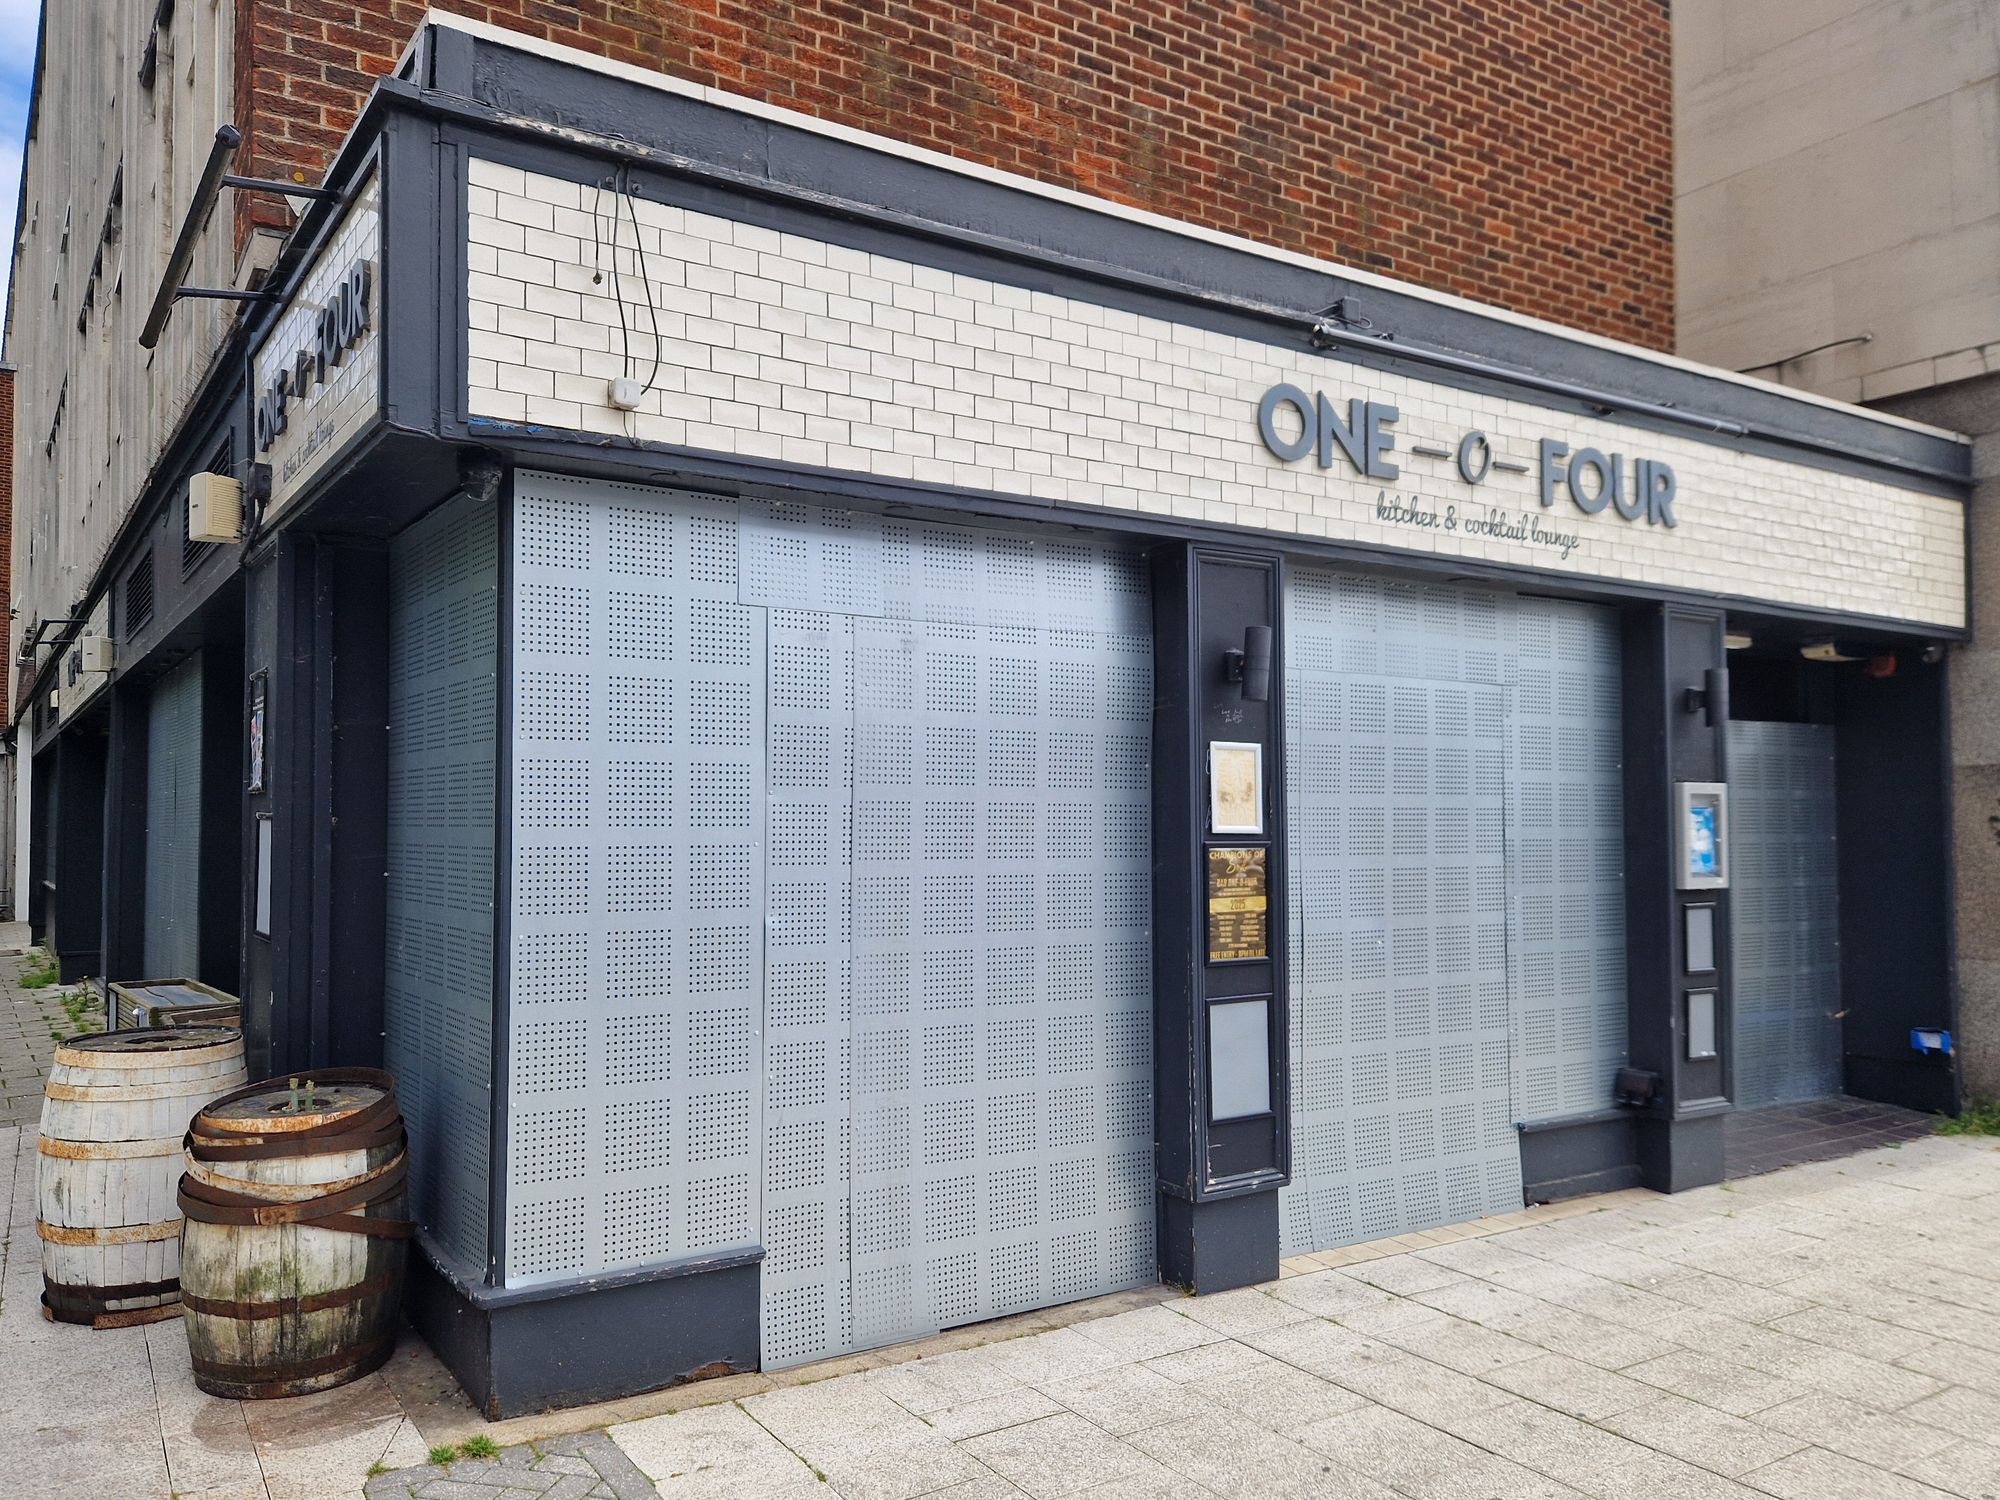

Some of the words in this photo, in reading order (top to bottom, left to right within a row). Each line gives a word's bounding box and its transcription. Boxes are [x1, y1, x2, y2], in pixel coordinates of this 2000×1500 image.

[257, 368, 288, 452] ONE
[315, 258, 371, 384] FOUR
[1257, 383, 1400, 481] ONE
[1539, 437, 1678, 529] FOUR
[1376, 490, 1440, 527] kitchen
[1444, 505, 1457, 530] &
[1465, 508, 1528, 542] cocktail
[1531, 515, 1580, 560] lounge
[1209, 850, 1253, 860] CHAMPIONS
[1230, 898, 1246, 910] 2025
